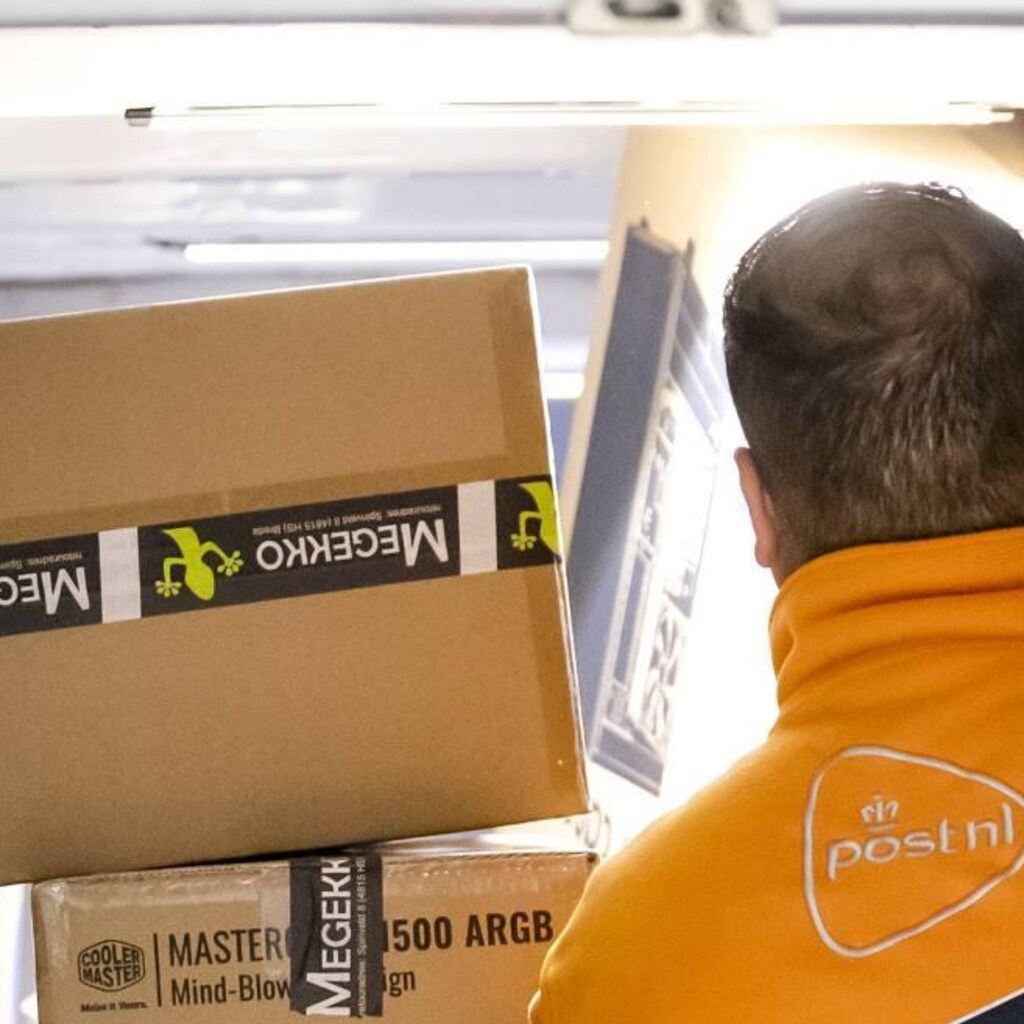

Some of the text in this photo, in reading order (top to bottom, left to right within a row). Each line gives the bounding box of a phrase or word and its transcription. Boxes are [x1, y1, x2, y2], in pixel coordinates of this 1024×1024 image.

[256, 519, 449, 571] MEGEKKO
[465, 910, 554, 947] ARGB
[81, 943, 140, 966] COOLER
[82, 965, 141, 988] MASTER
